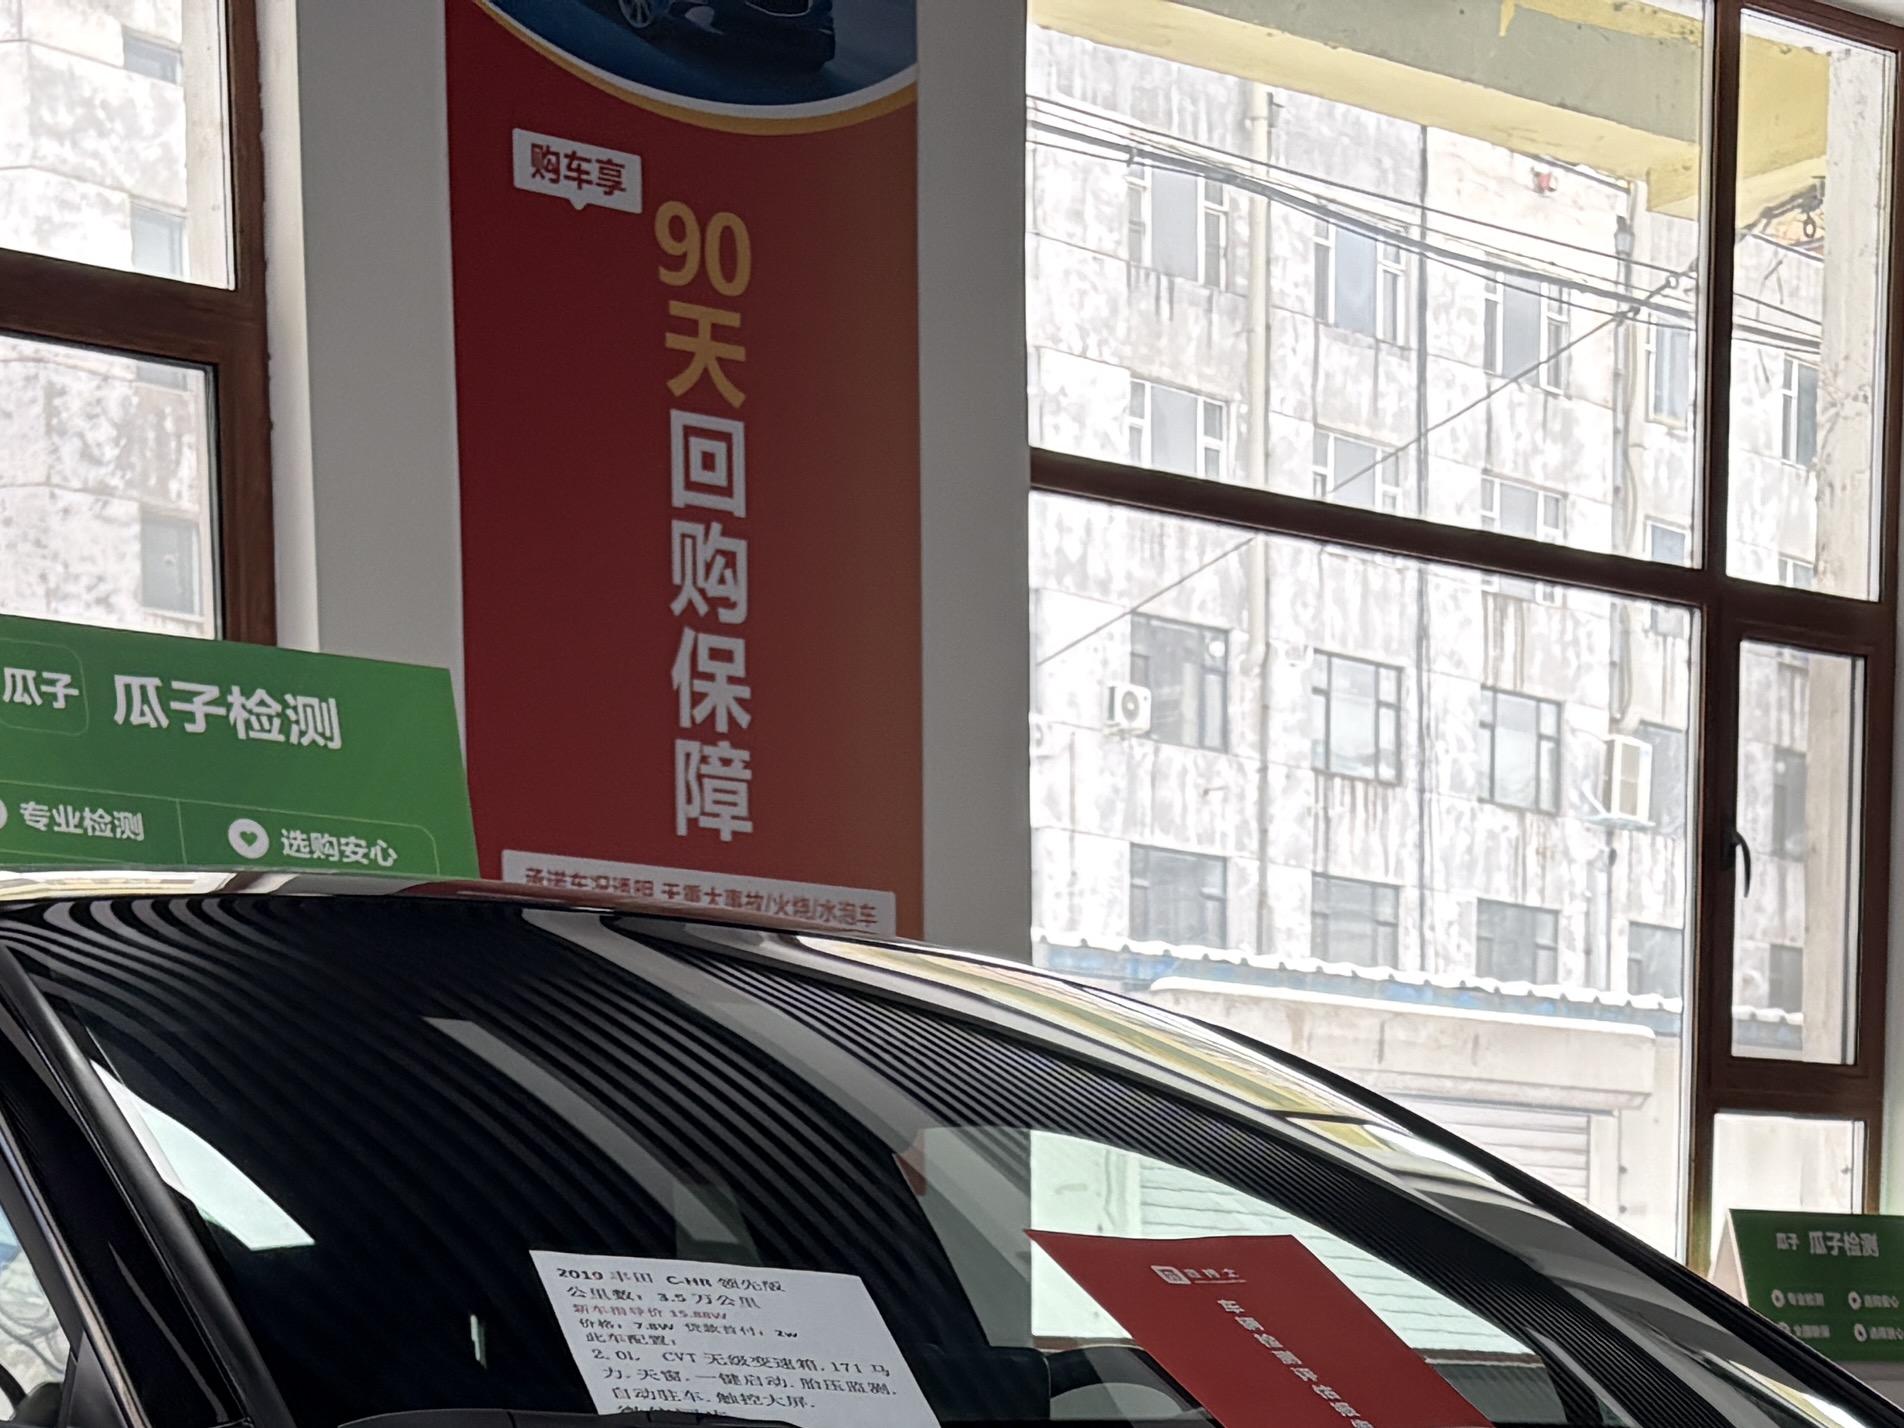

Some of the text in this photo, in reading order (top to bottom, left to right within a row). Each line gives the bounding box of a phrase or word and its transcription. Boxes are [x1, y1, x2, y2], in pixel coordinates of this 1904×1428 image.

[530, 142, 627, 197] 购车享
[653, 200, 754, 842] 90天回购保障
[1, 667, 81, 710] 瓜子
[112, 673, 343, 750] 瓜子检测
[20, 800, 145, 842] 专业检测
[281, 828, 398, 867] 选购安心
[1809, 1231, 1879, 1257] 瓜子检测
[661, 1351, 697, 1363] CVT
